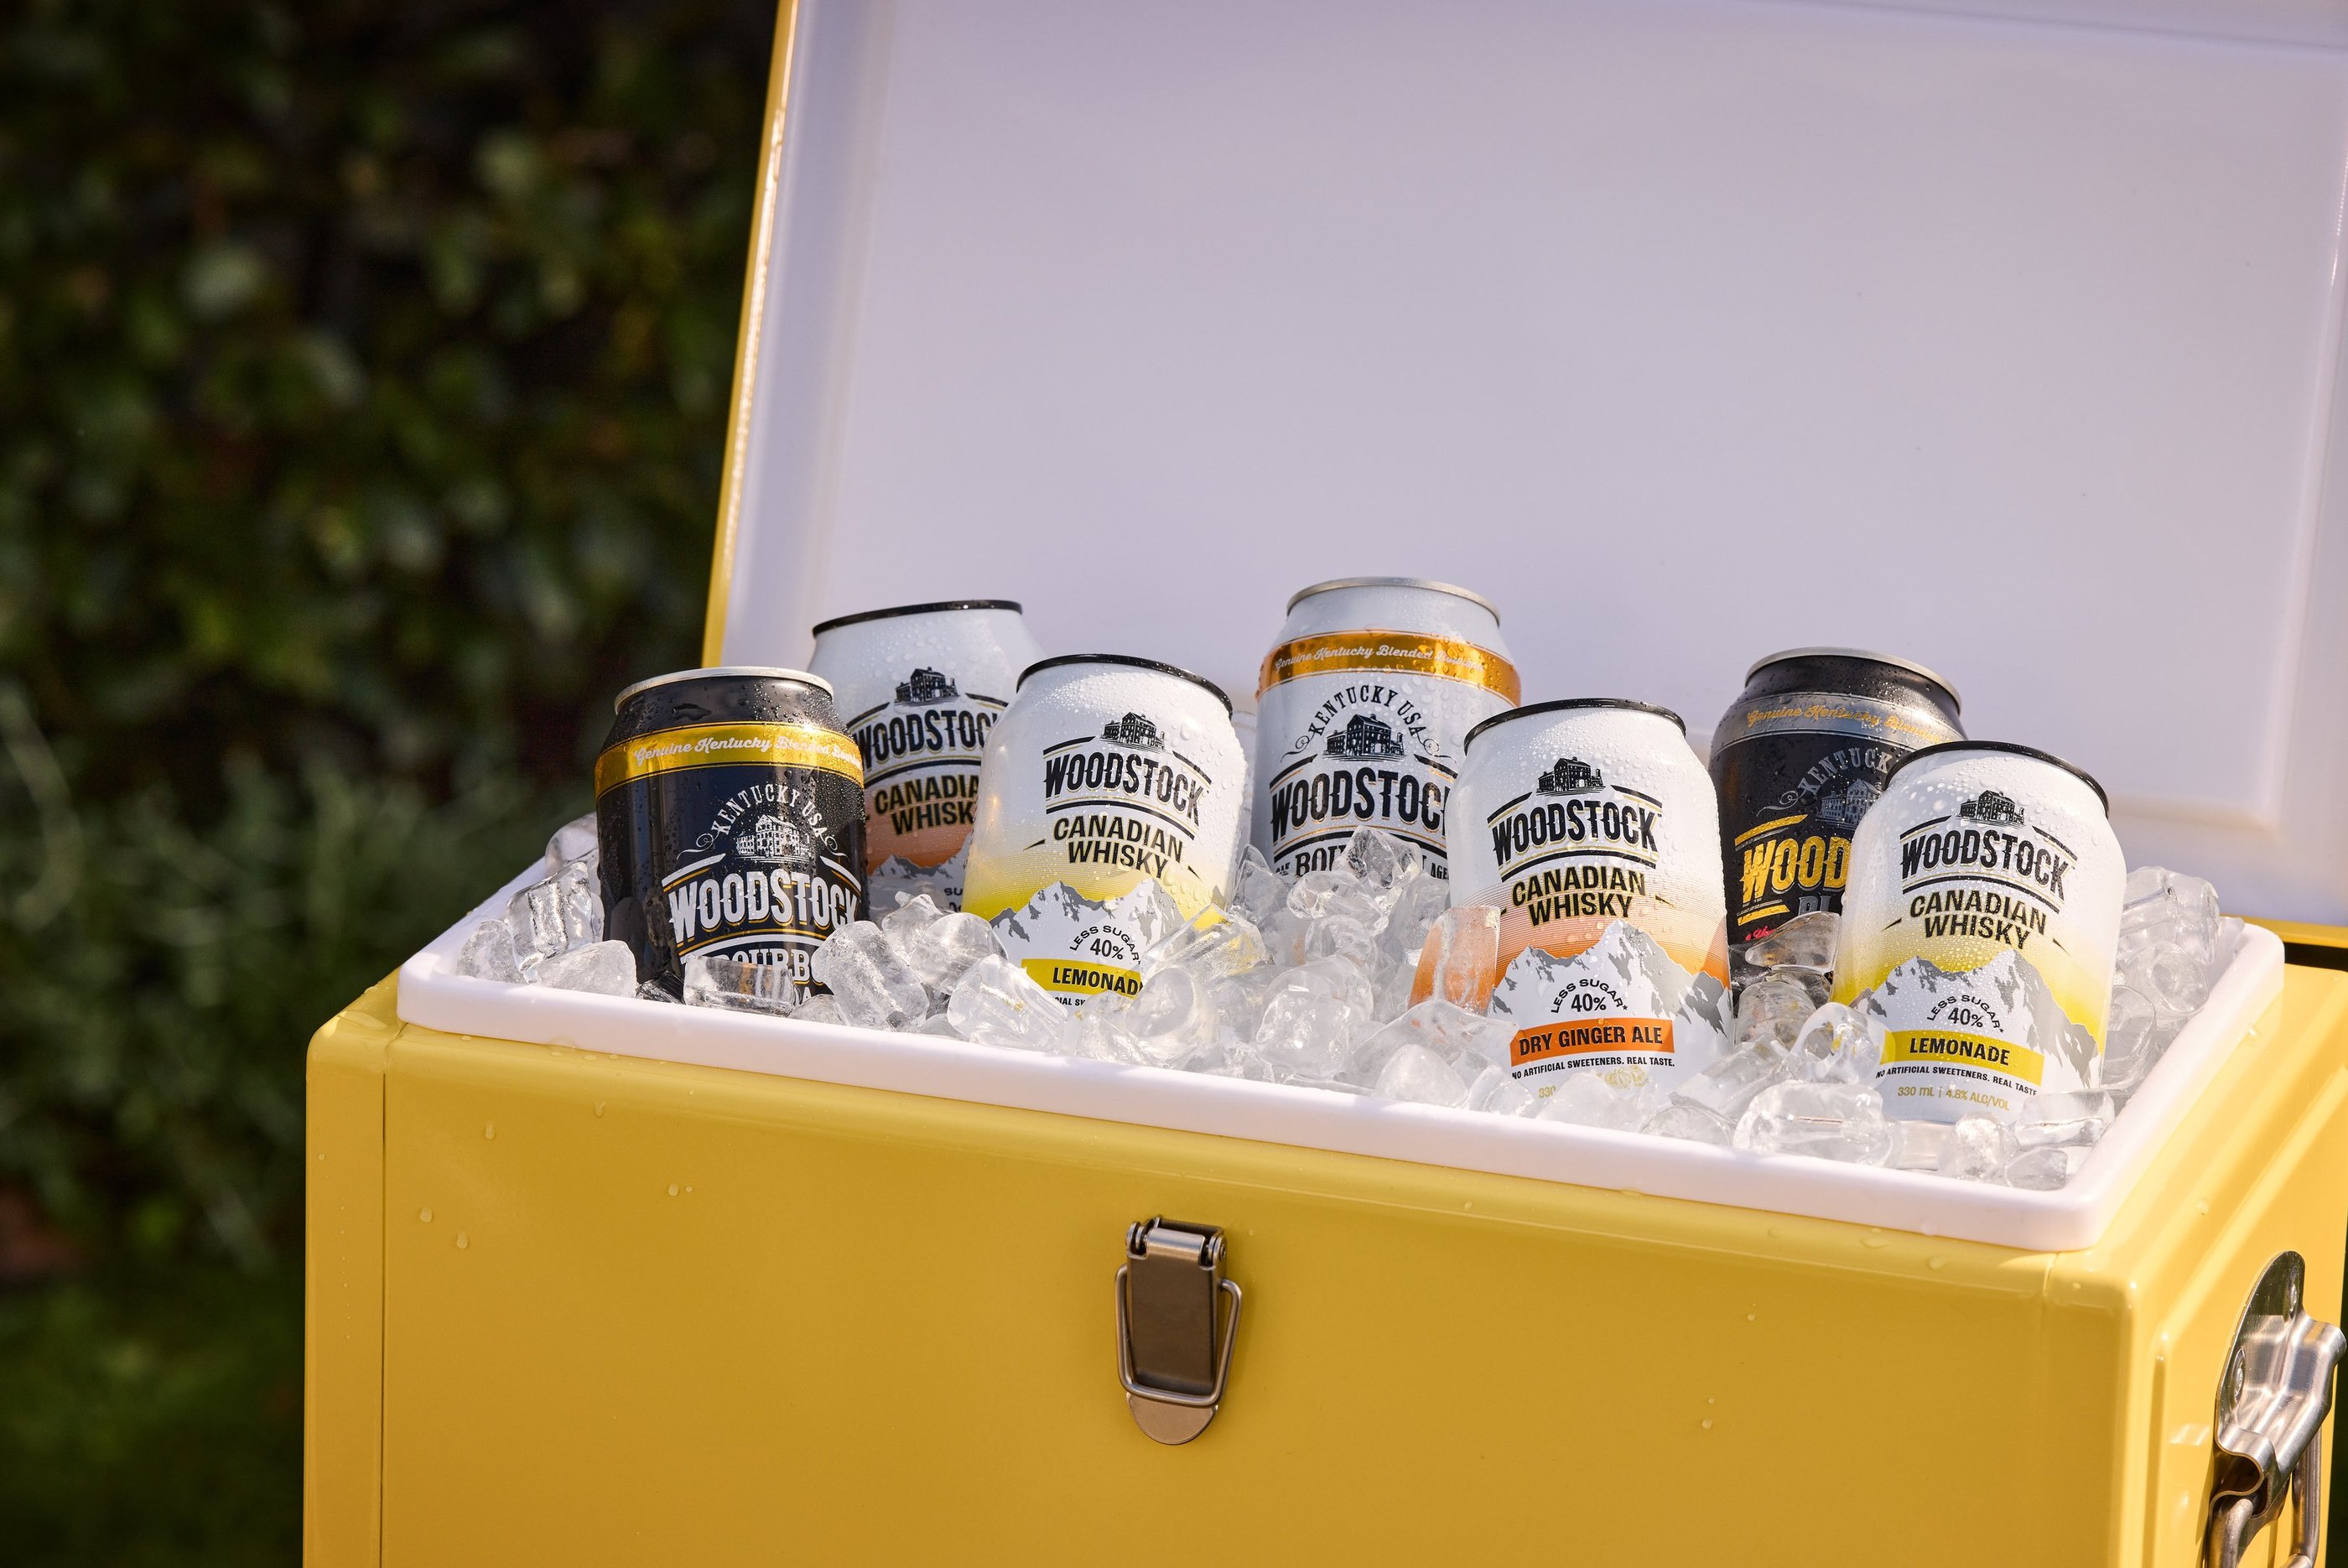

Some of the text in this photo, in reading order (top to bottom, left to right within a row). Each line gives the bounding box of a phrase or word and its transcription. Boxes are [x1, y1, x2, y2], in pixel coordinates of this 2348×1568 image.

[1275, 652, 1312, 672] Genuine
[1313, 645, 1374, 661] Kentucky
[1376, 644, 1433, 659] Blended
[1308, 684, 1426, 735] KENTUCKY USA
[1747, 706, 1802, 728] Genuine
[1804, 705, 1882, 726] Kentucky
[635, 742, 692, 766] Genuine
[693, 737, 772, 754] Kentucky
[854, 709, 997, 769] WOODSTOC
[1798, 747, 1893, 795] KENTUCK
[875, 775, 979, 815] CANADIA
[1044, 752, 1204, 828] WOODSTOCK
[711, 783, 829, 838] KENTUCKY USA
[891, 800, 976, 835] WHISK
[1053, 815, 1183, 863] CANADIAN
[1493, 799, 1658, 866] WOODSTOCK
[1068, 840, 1168, 879] WHISKY
[1430, 863, 1449, 880] AGE
[1900, 829, 2069, 901] WOODSTOCK
[1513, 865, 1645, 906] CANADIAN
[669, 869, 858, 942] WOODSTOCK
[1528, 892, 1633, 926] WHISKY
[1910, 890, 2046, 935] CANADIAN
[1069, 926, 1099, 952] LESS
[1925, 915, 2030, 949] WHISKY
[1090, 937, 1125, 960] 40%
[1052, 967, 1144, 996] LEMONAD
[1551, 983, 1577, 1013] LESS
[1571, 994, 1607, 1012] 40%
[1927, 996, 1956, 1021] LESS
[1948, 1007, 1983, 1028] 40%
[1519, 1025, 1663, 1056] DRY GINGER ALE
[1909, 1037, 2010, 1066] LEMONADE
[1524, 1062, 1566, 1077] ARTIFICIAL
[1567, 1057, 1624, 1068] SWEETENERS.
[1627, 1057, 1647, 1065] REAL
[1649, 1057, 1675, 1067] TASTE.
[1876, 1069, 1885, 1079] NO
[1886, 1066, 1930, 1075] ARTIFICIAL
[1932, 1067, 1990, 1082] SWEETENERS.
[1992, 1076, 2013, 1088] REAL
[1898, 1087, 2010, 1111] 330 mL 4.8% ALC/VOL
